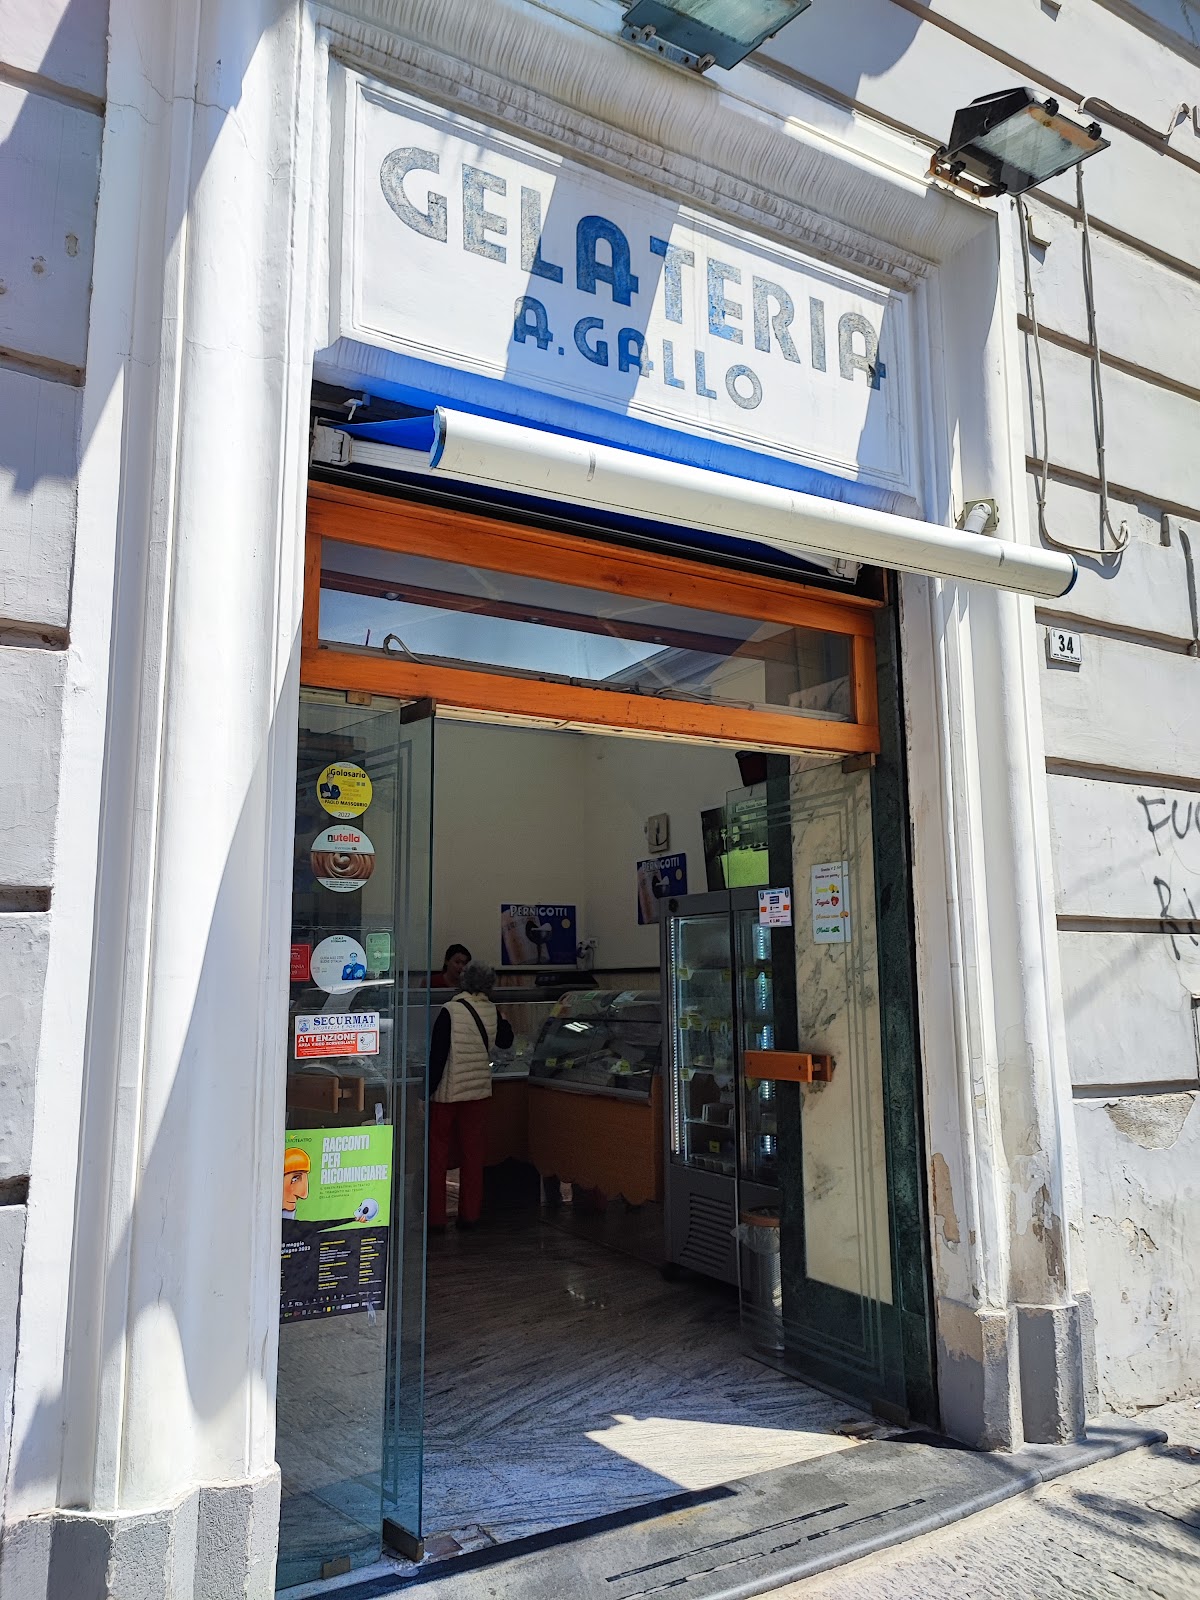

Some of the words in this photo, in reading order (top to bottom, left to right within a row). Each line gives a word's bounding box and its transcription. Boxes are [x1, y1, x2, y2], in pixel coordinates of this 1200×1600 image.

[380, 146, 887, 391] GELATERIA
[1058, 634, 1074, 654] 34
[330, 768, 366, 779] Golosario
[327, 834, 361, 842] nutella
[313, 1015, 376, 1026] SECURMAT
[298, 1033, 356, 1043] ATTENZIONE
[322, 1134, 370, 1152] RACCONTI
[321, 1153, 341, 1168] PER
[320, 1165, 388, 1185] RICOMINCIARE
